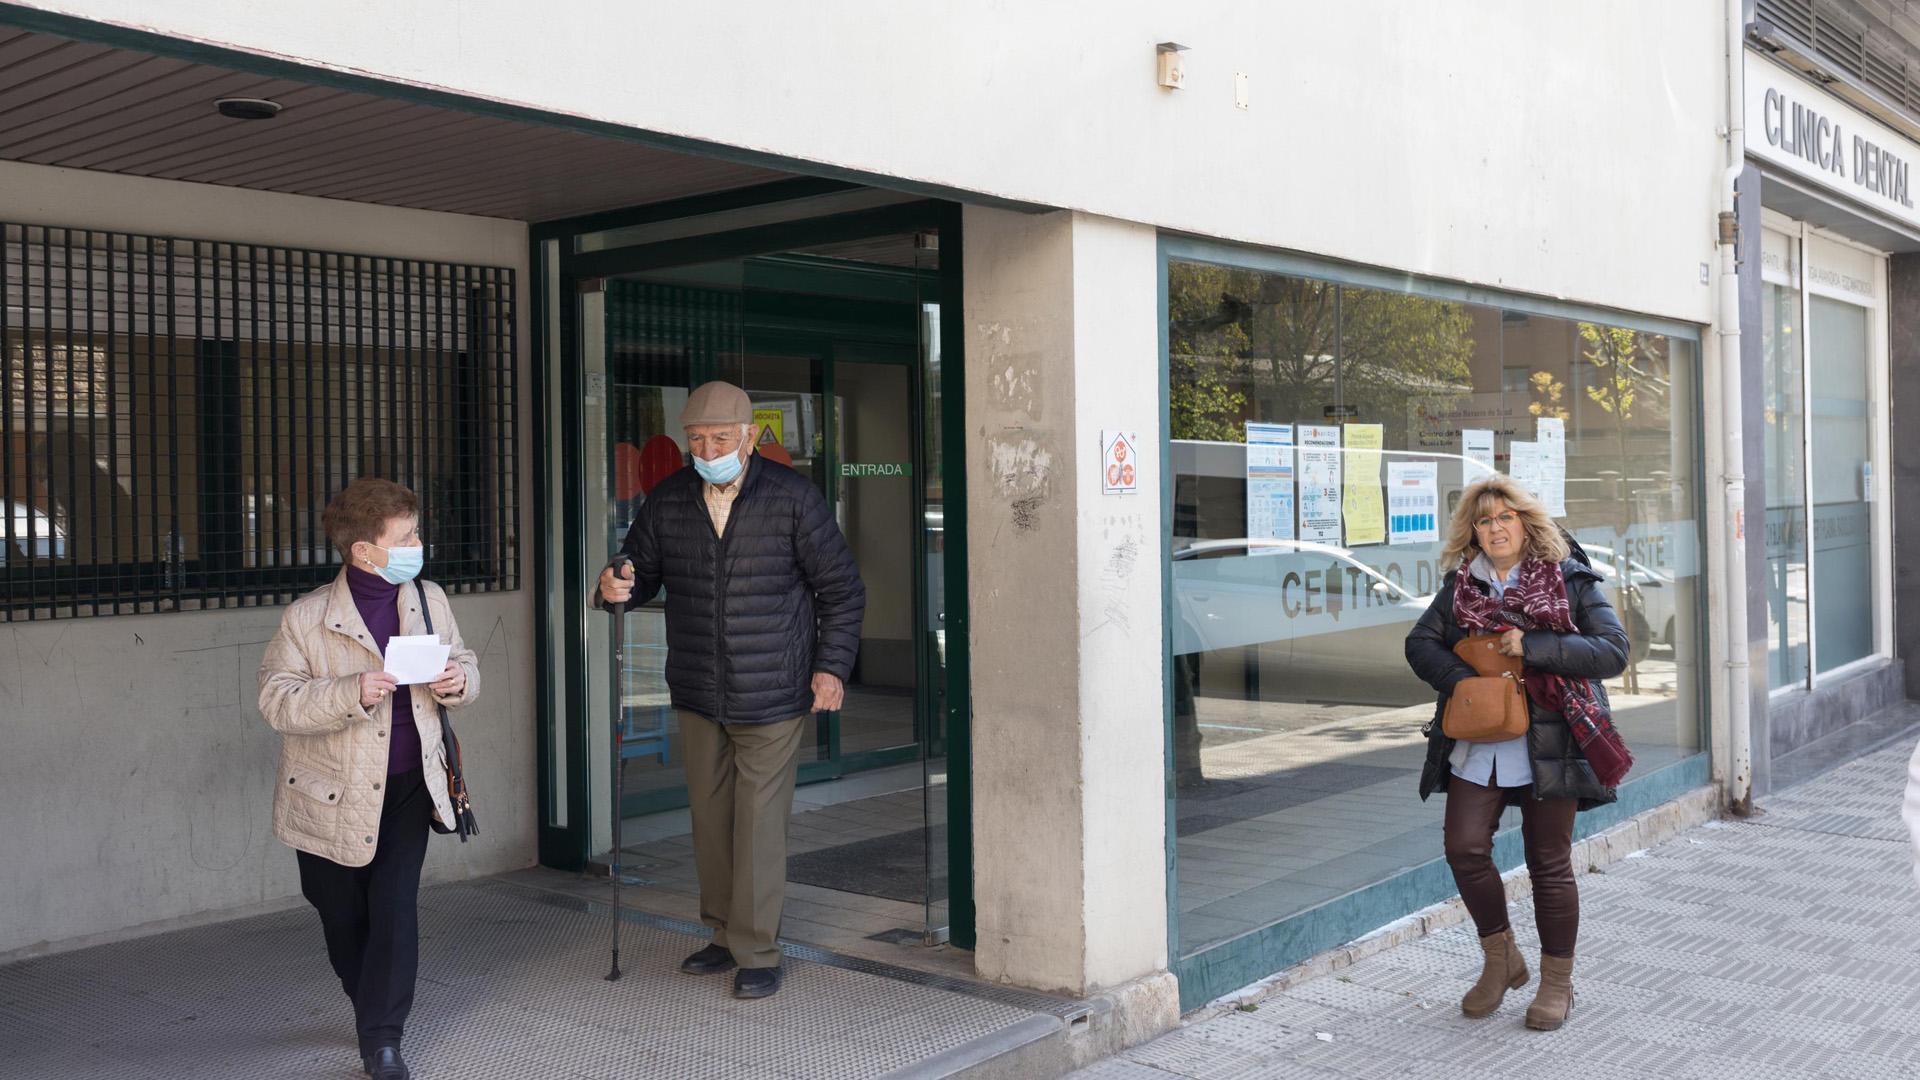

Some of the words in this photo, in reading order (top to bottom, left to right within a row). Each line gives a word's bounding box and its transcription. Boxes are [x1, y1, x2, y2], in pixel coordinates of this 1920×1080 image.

[1764, 87, 1846, 178] CLINICA
[1853, 134, 1914, 209] DENTAL
[841, 463, 903, 476] ENTRADA
[1625, 536, 1665, 572] ESTE
